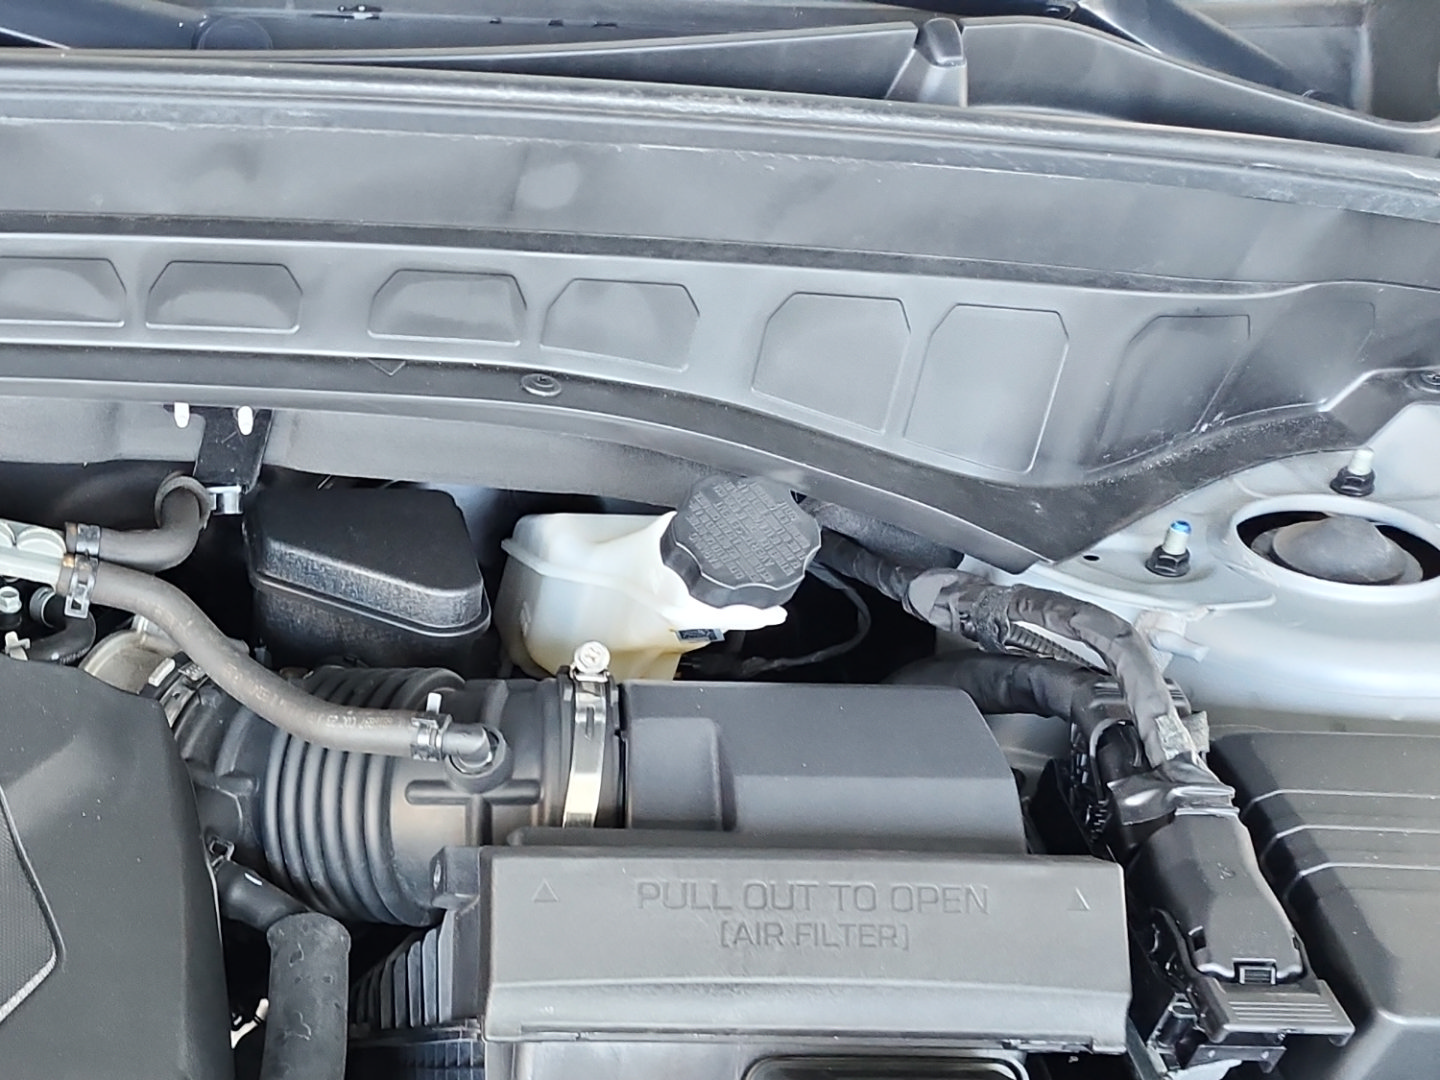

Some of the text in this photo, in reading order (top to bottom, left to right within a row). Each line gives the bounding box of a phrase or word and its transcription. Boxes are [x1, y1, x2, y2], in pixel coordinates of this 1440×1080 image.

[636, 880, 990, 915] PULL OUT TO OPEN
